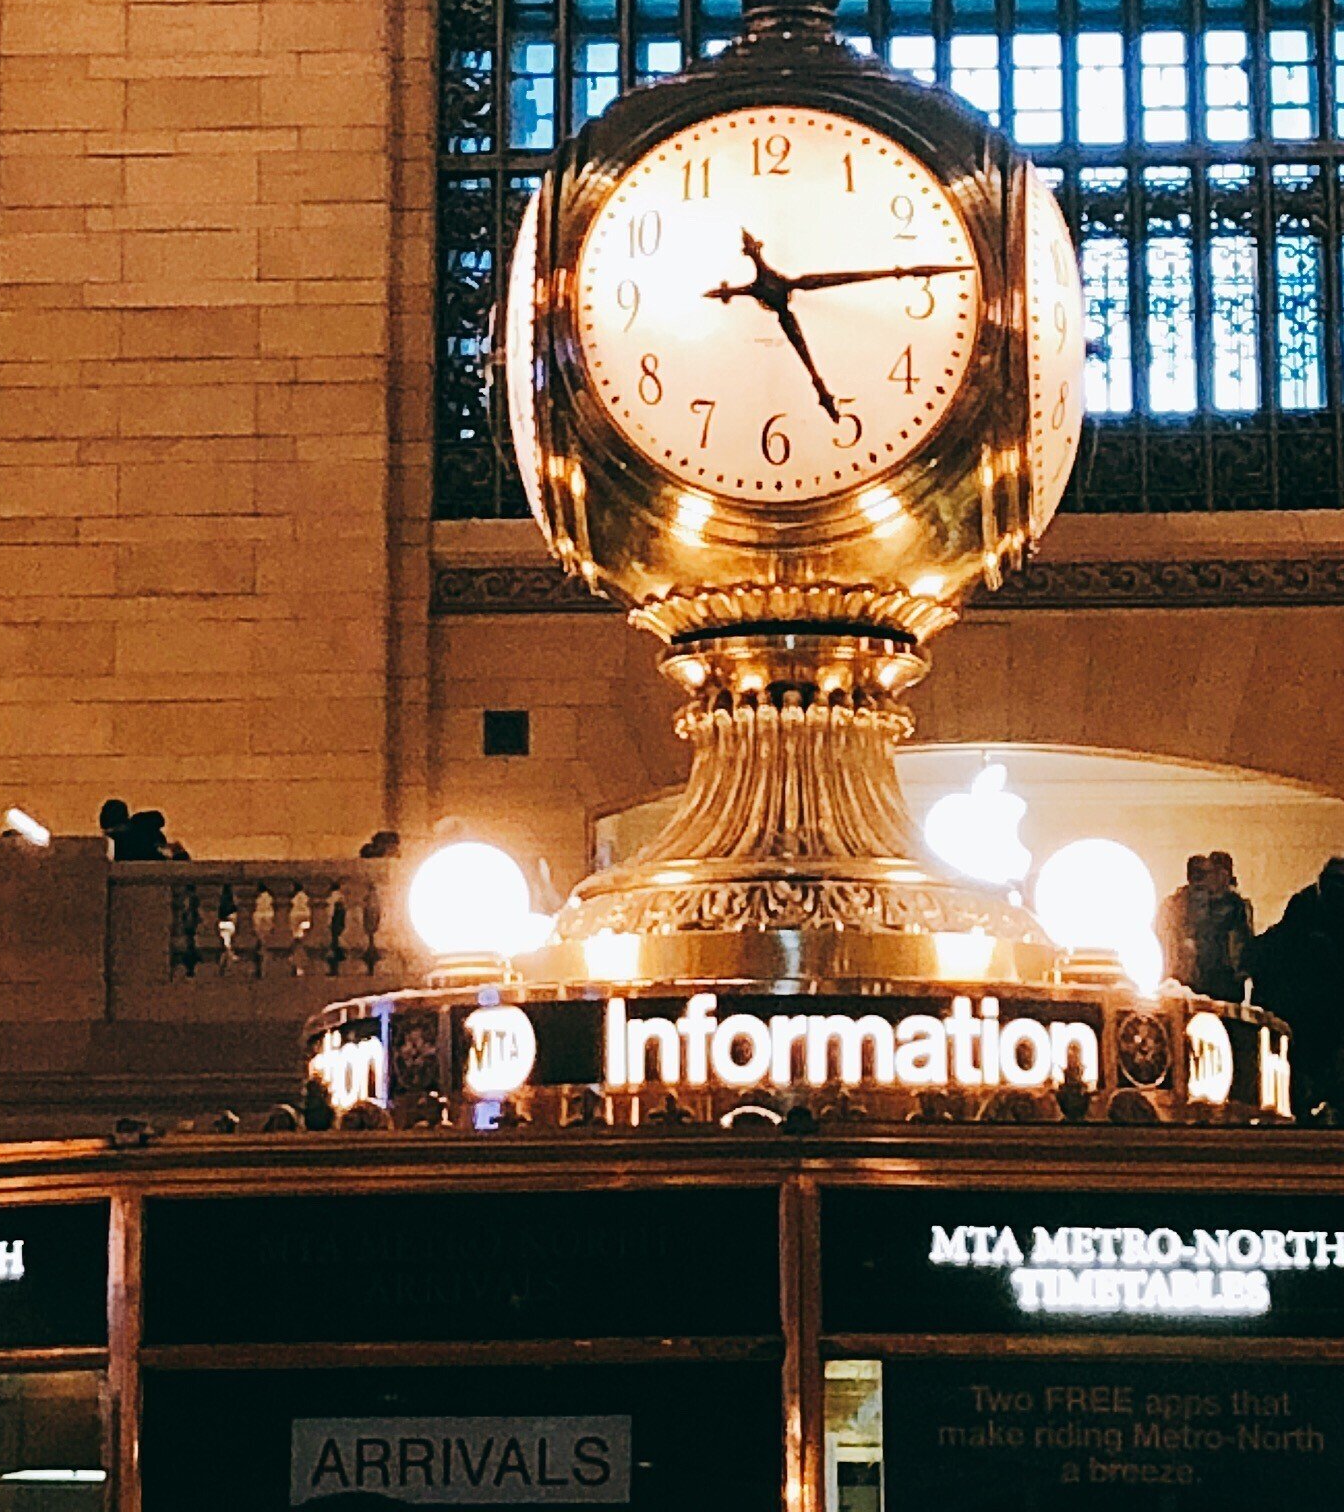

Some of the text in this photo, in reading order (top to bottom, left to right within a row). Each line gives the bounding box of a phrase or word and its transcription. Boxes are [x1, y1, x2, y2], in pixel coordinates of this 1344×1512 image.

[752, 134, 791, 176] 12
[843, 154, 855, 192] 1
[682, 157, 711, 201] 11
[628, 210, 661, 257] 10
[890, 195, 917, 239] 2
[617, 280, 641, 332] 9
[904, 274, 935, 319] 3
[638, 354, 662, 405] 8
[888, 345, 920, 393] 4
[690, 401, 715, 448] 7
[761, 414, 791, 465] 6
[832, 398, 862, 448] 5
[604, 995, 1097, 1088] Information
[929, 1226, 1023, 1266] MTA
[1010, 1269, 1270, 1312] TIMETABLES
[970, 1384, 1291, 1420] Two FREE apps that
[938, 1422, 1325, 1453] make riding Metro-North
[311, 1436, 611, 1487] ARRIVALS
[1060, 1462, 1080, 1484] a
